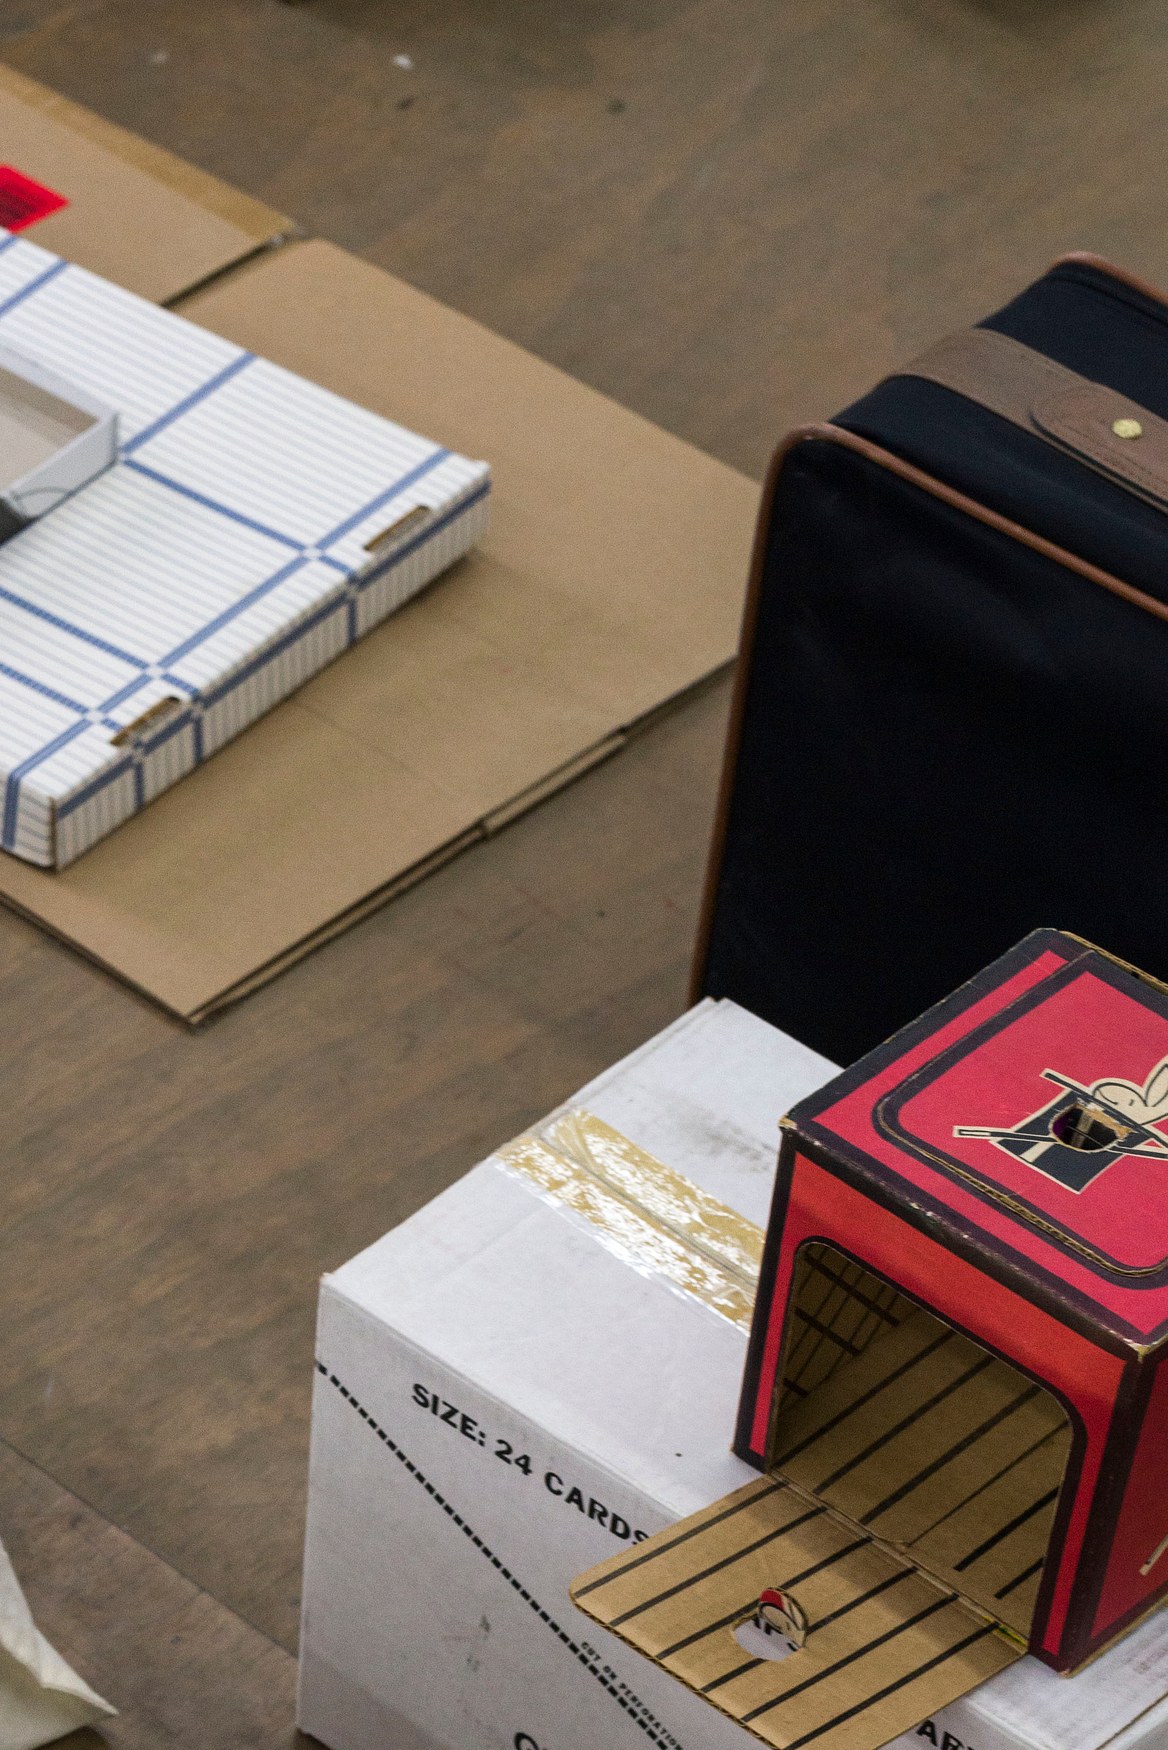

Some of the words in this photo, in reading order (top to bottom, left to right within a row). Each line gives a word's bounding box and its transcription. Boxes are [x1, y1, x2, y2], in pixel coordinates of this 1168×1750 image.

[412, 1383, 486, 1447] SIZE:
[494, 1439, 533, 1476] 24
[581, 1641, 601, 1662] CUT
[603, 1665, 617, 1681] ON
